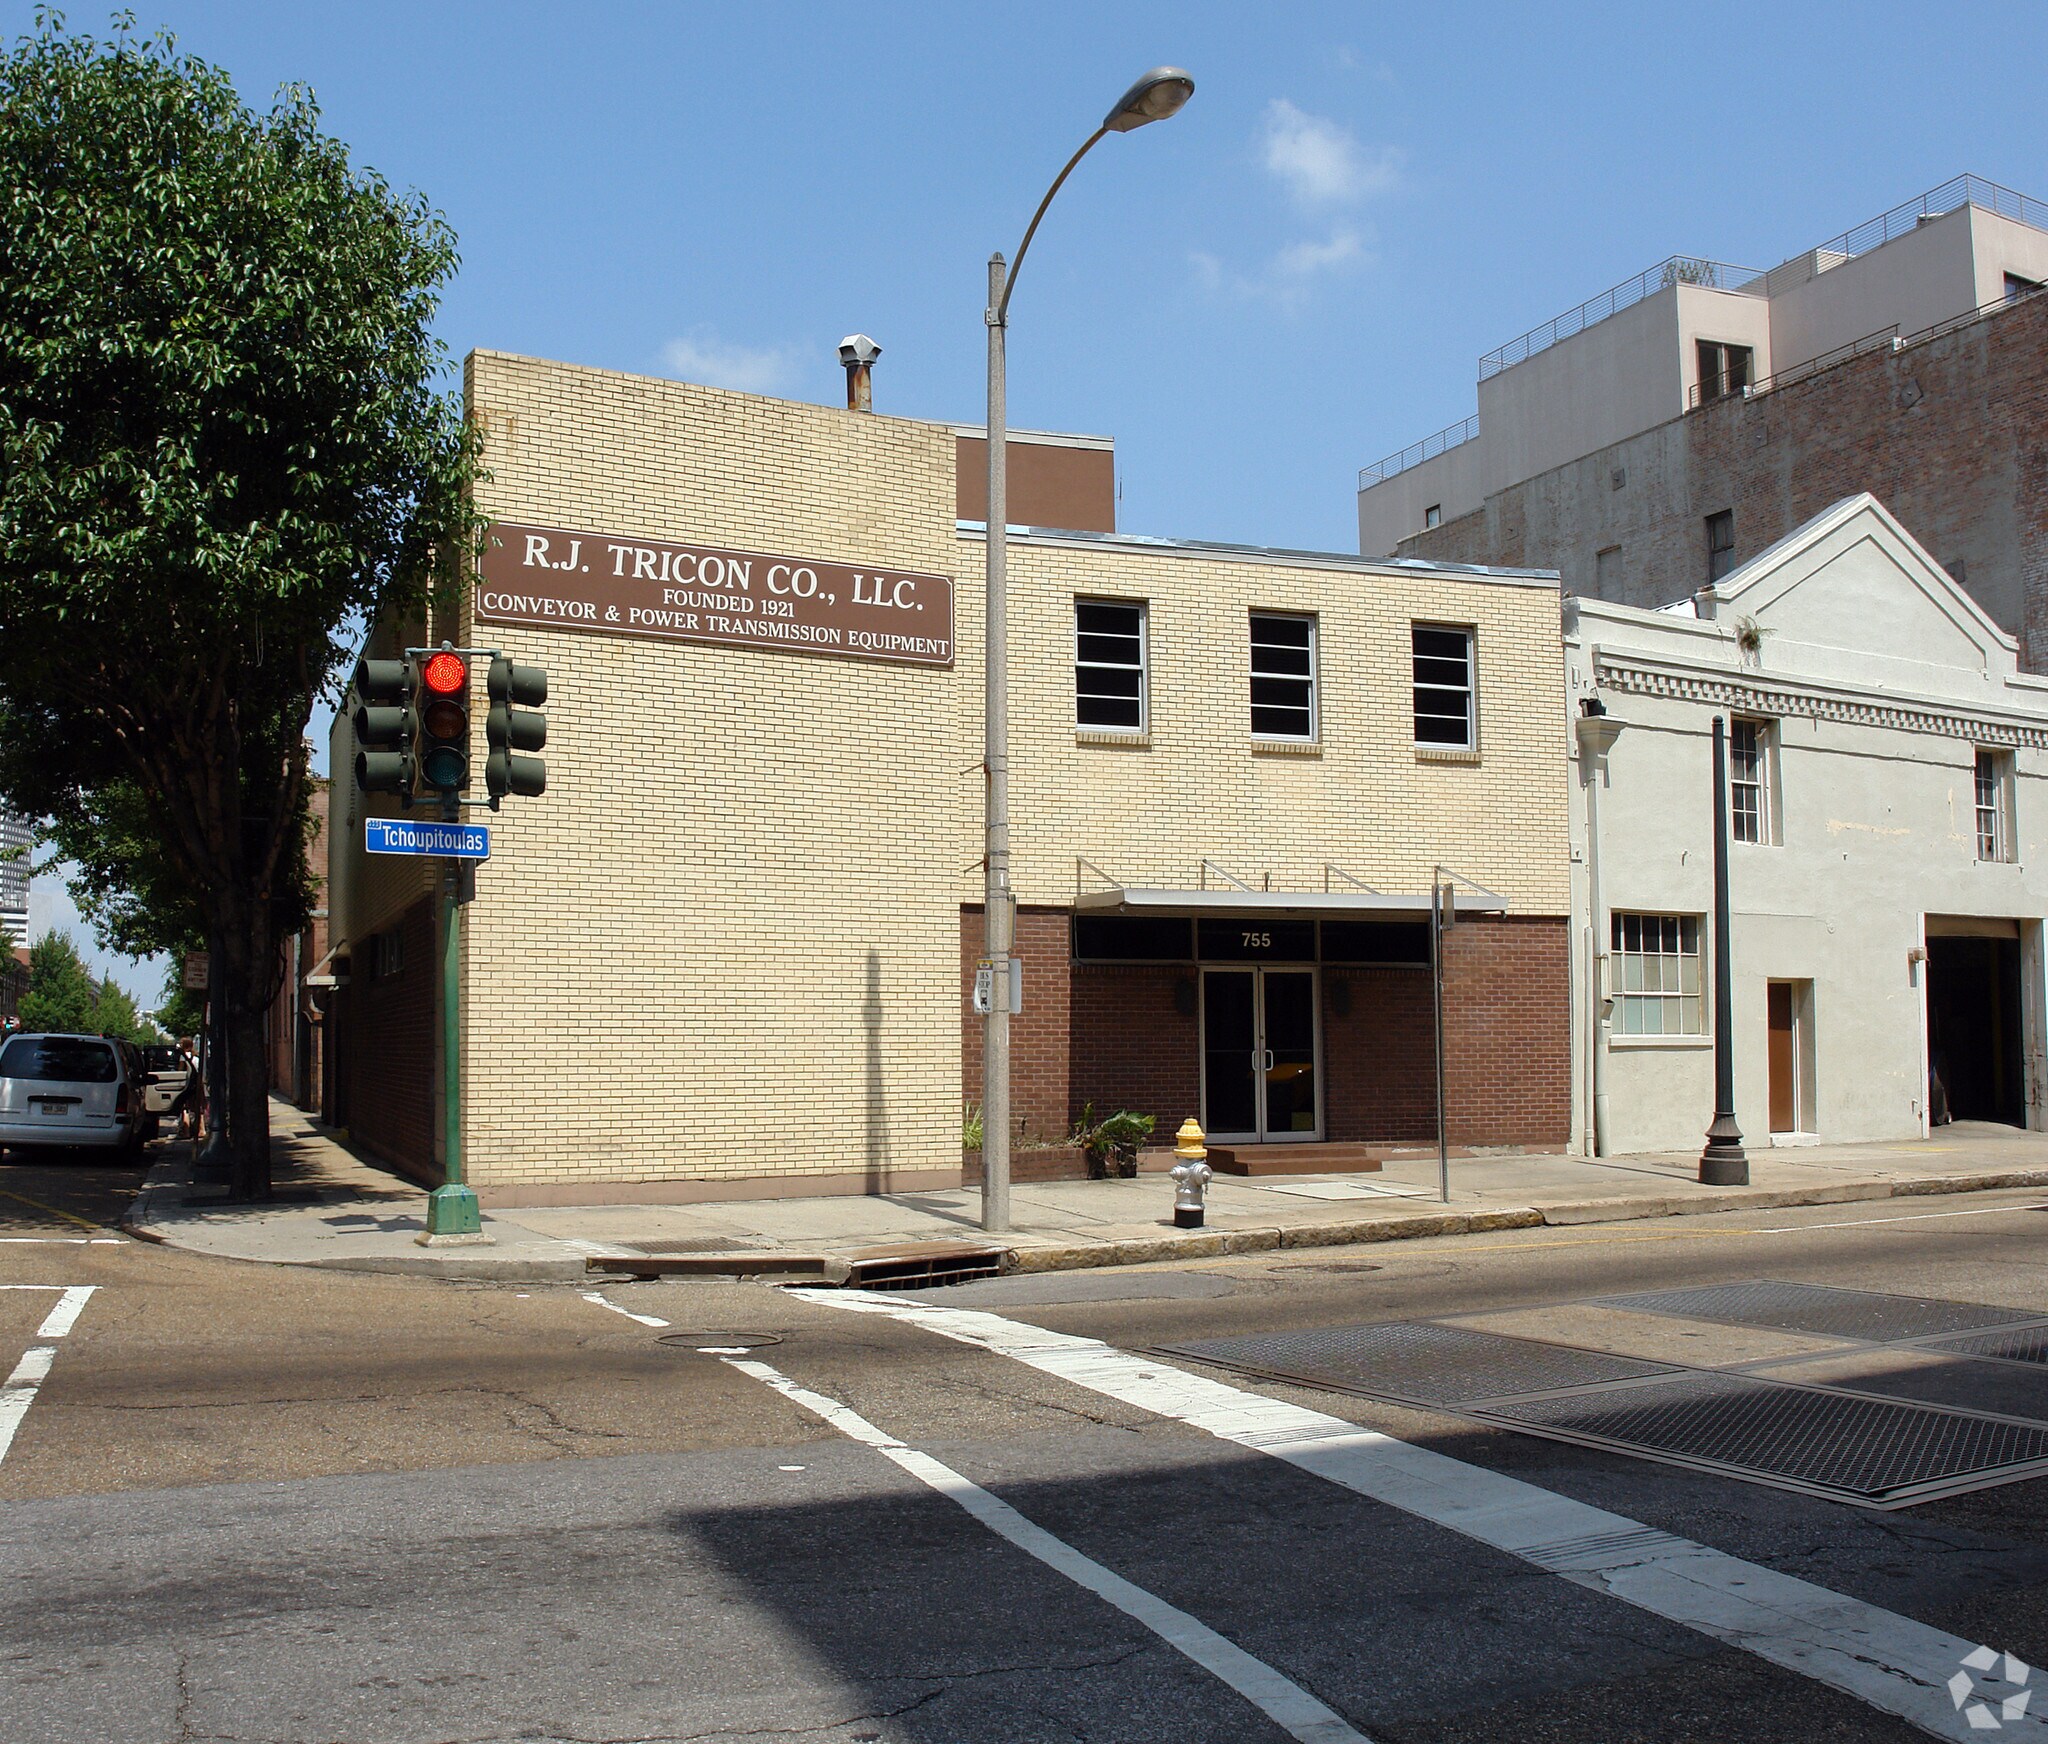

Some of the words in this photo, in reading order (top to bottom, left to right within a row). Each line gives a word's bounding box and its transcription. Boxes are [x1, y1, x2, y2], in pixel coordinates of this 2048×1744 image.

[522, 534, 590, 573] R.J.
[607, 544, 752, 591] TRICON
[766, 564, 836, 607] CO.,
[851, 574, 924, 611] LLC.
[663, 588, 754, 613] FOUNDED
[761, 599, 795, 618] 1921
[483, 592, 598, 620] CONVEYOR
[604, 605, 621, 622] &
[629, 607, 699, 630] POWER
[706, 615, 841, 645] TRANSMISSION
[848, 630, 949, 656] EQUIPMENT
[382, 825, 483, 852] Tchoupitoulas
[1241, 932, 1271, 947] 755
